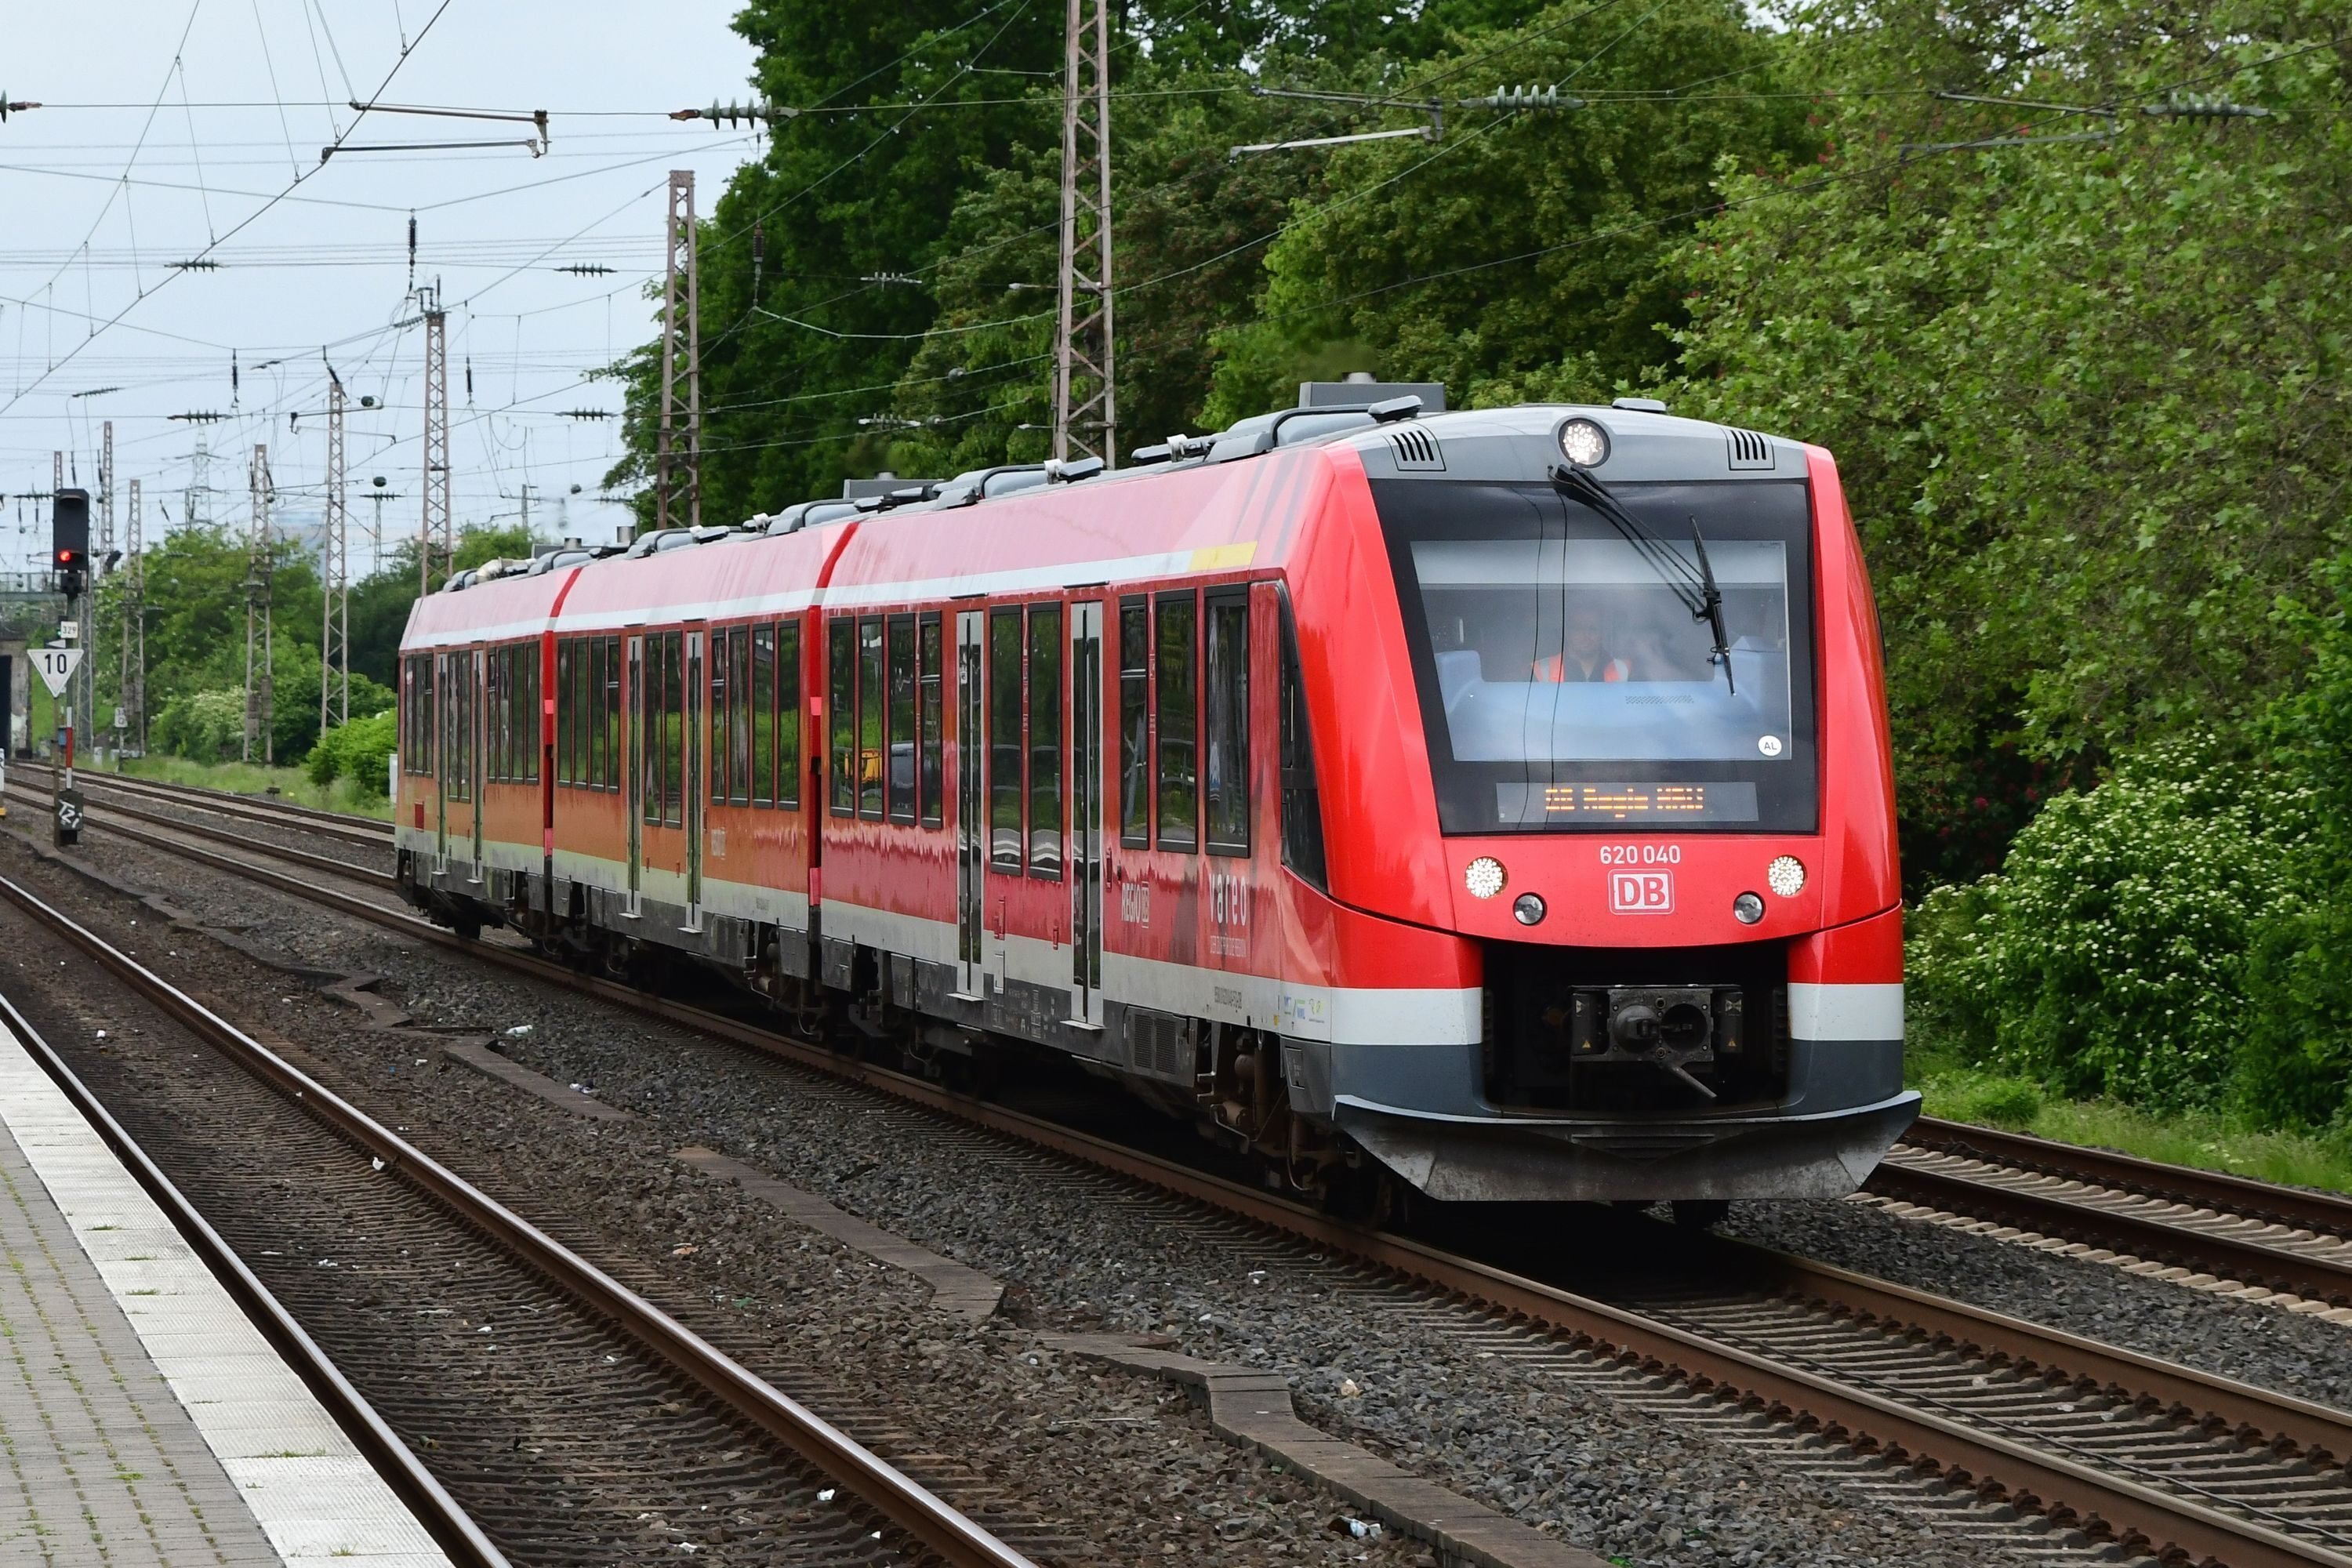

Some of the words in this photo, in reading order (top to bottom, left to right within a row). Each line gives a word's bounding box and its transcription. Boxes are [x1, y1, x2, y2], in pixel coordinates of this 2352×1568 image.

[45, 653, 67, 674] 10
[1764, 741, 1777, 750] AL
[1600, 845, 1639, 864] 620
[1643, 844, 1681, 864] 040
[1209, 873, 1247, 927] vareo
[1617, 877, 1667, 906] DB
